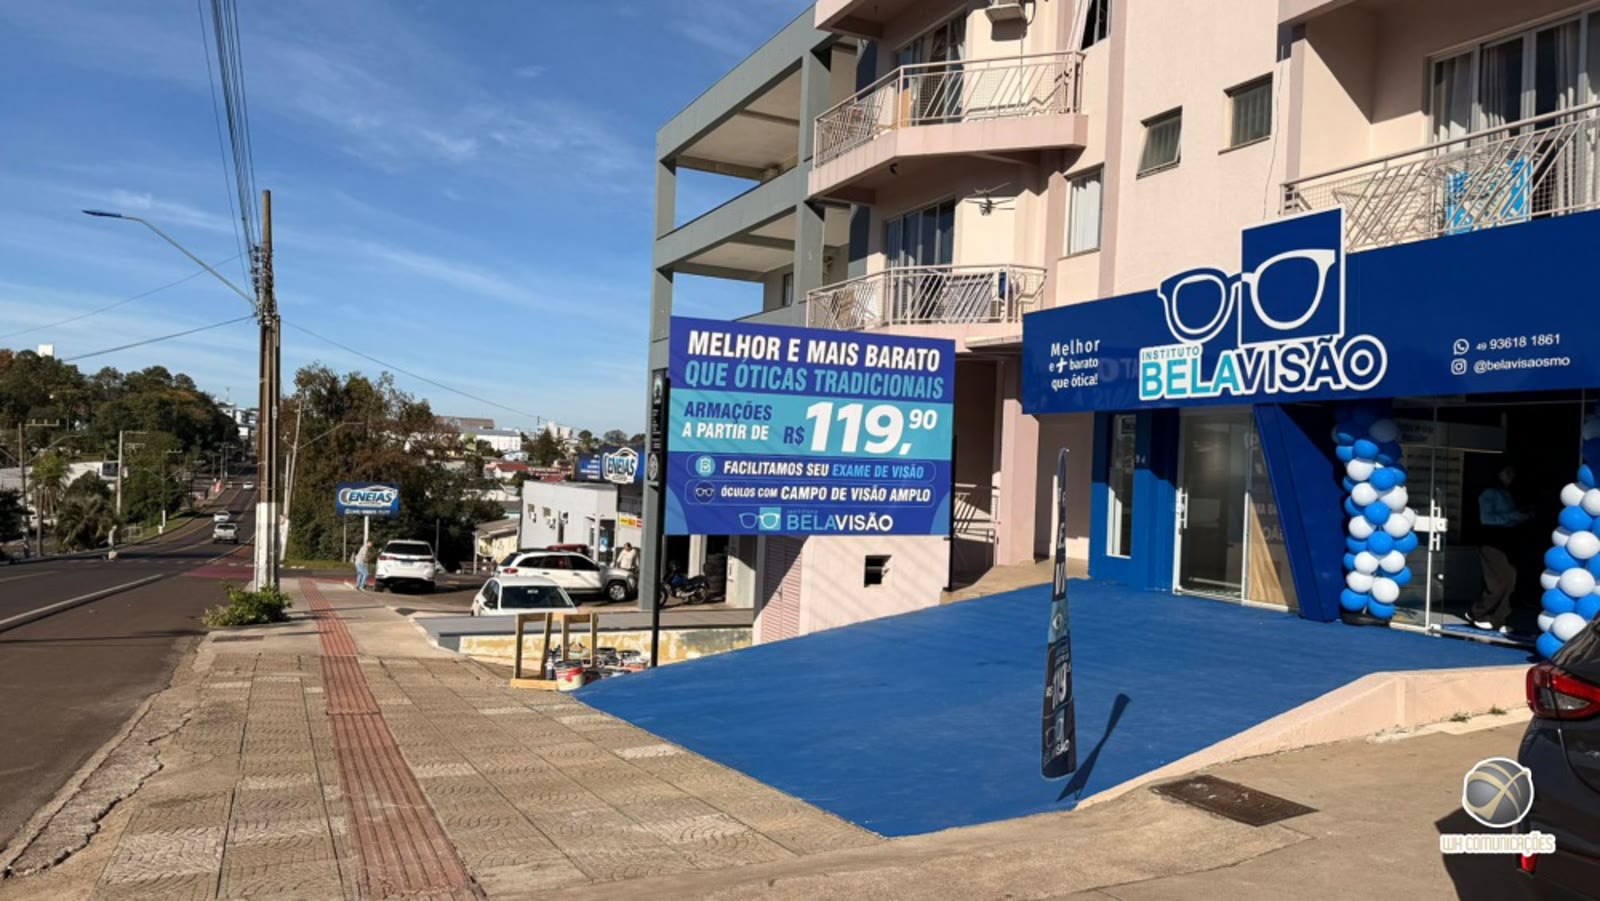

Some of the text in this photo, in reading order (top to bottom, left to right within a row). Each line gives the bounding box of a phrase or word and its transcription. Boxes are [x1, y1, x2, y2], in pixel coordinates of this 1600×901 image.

[688, 330, 940, 372] MELHOR E MAIS BARATO
[1051, 338, 1100, 357] Melhor
[1475, 333, 1561, 351] 49 93618 1861
[1141, 345, 1202, 361] INSTITUTO
[1048, 362, 1055, 372] e
[1069, 357, 1099, 370] barato
[1139, 333, 1388, 402] BELAVISÃO
[1473, 356, 1570, 374] @belavisaosmo
[685, 357, 944, 400] QUE ÓTICAS TRADICIONAIS
[1051, 372, 1099, 392] que ótica!
[684, 400, 772, 425] ARMAÇÕES
[682, 424, 692, 438] A
[696, 424, 746, 440] PARTIR
[751, 425, 769, 440] DE
[783, 425, 805, 445] R$
[723, 460, 924, 479] FACILITAMOS SEU EXAME DE VISÃO
[348, 491, 393, 503] ENEIAS
[721, 485, 931, 502] ÓCULOS COM CAMPO DE VISÃO AMPLO
[786, 512, 894, 532] BELAVISÃO
